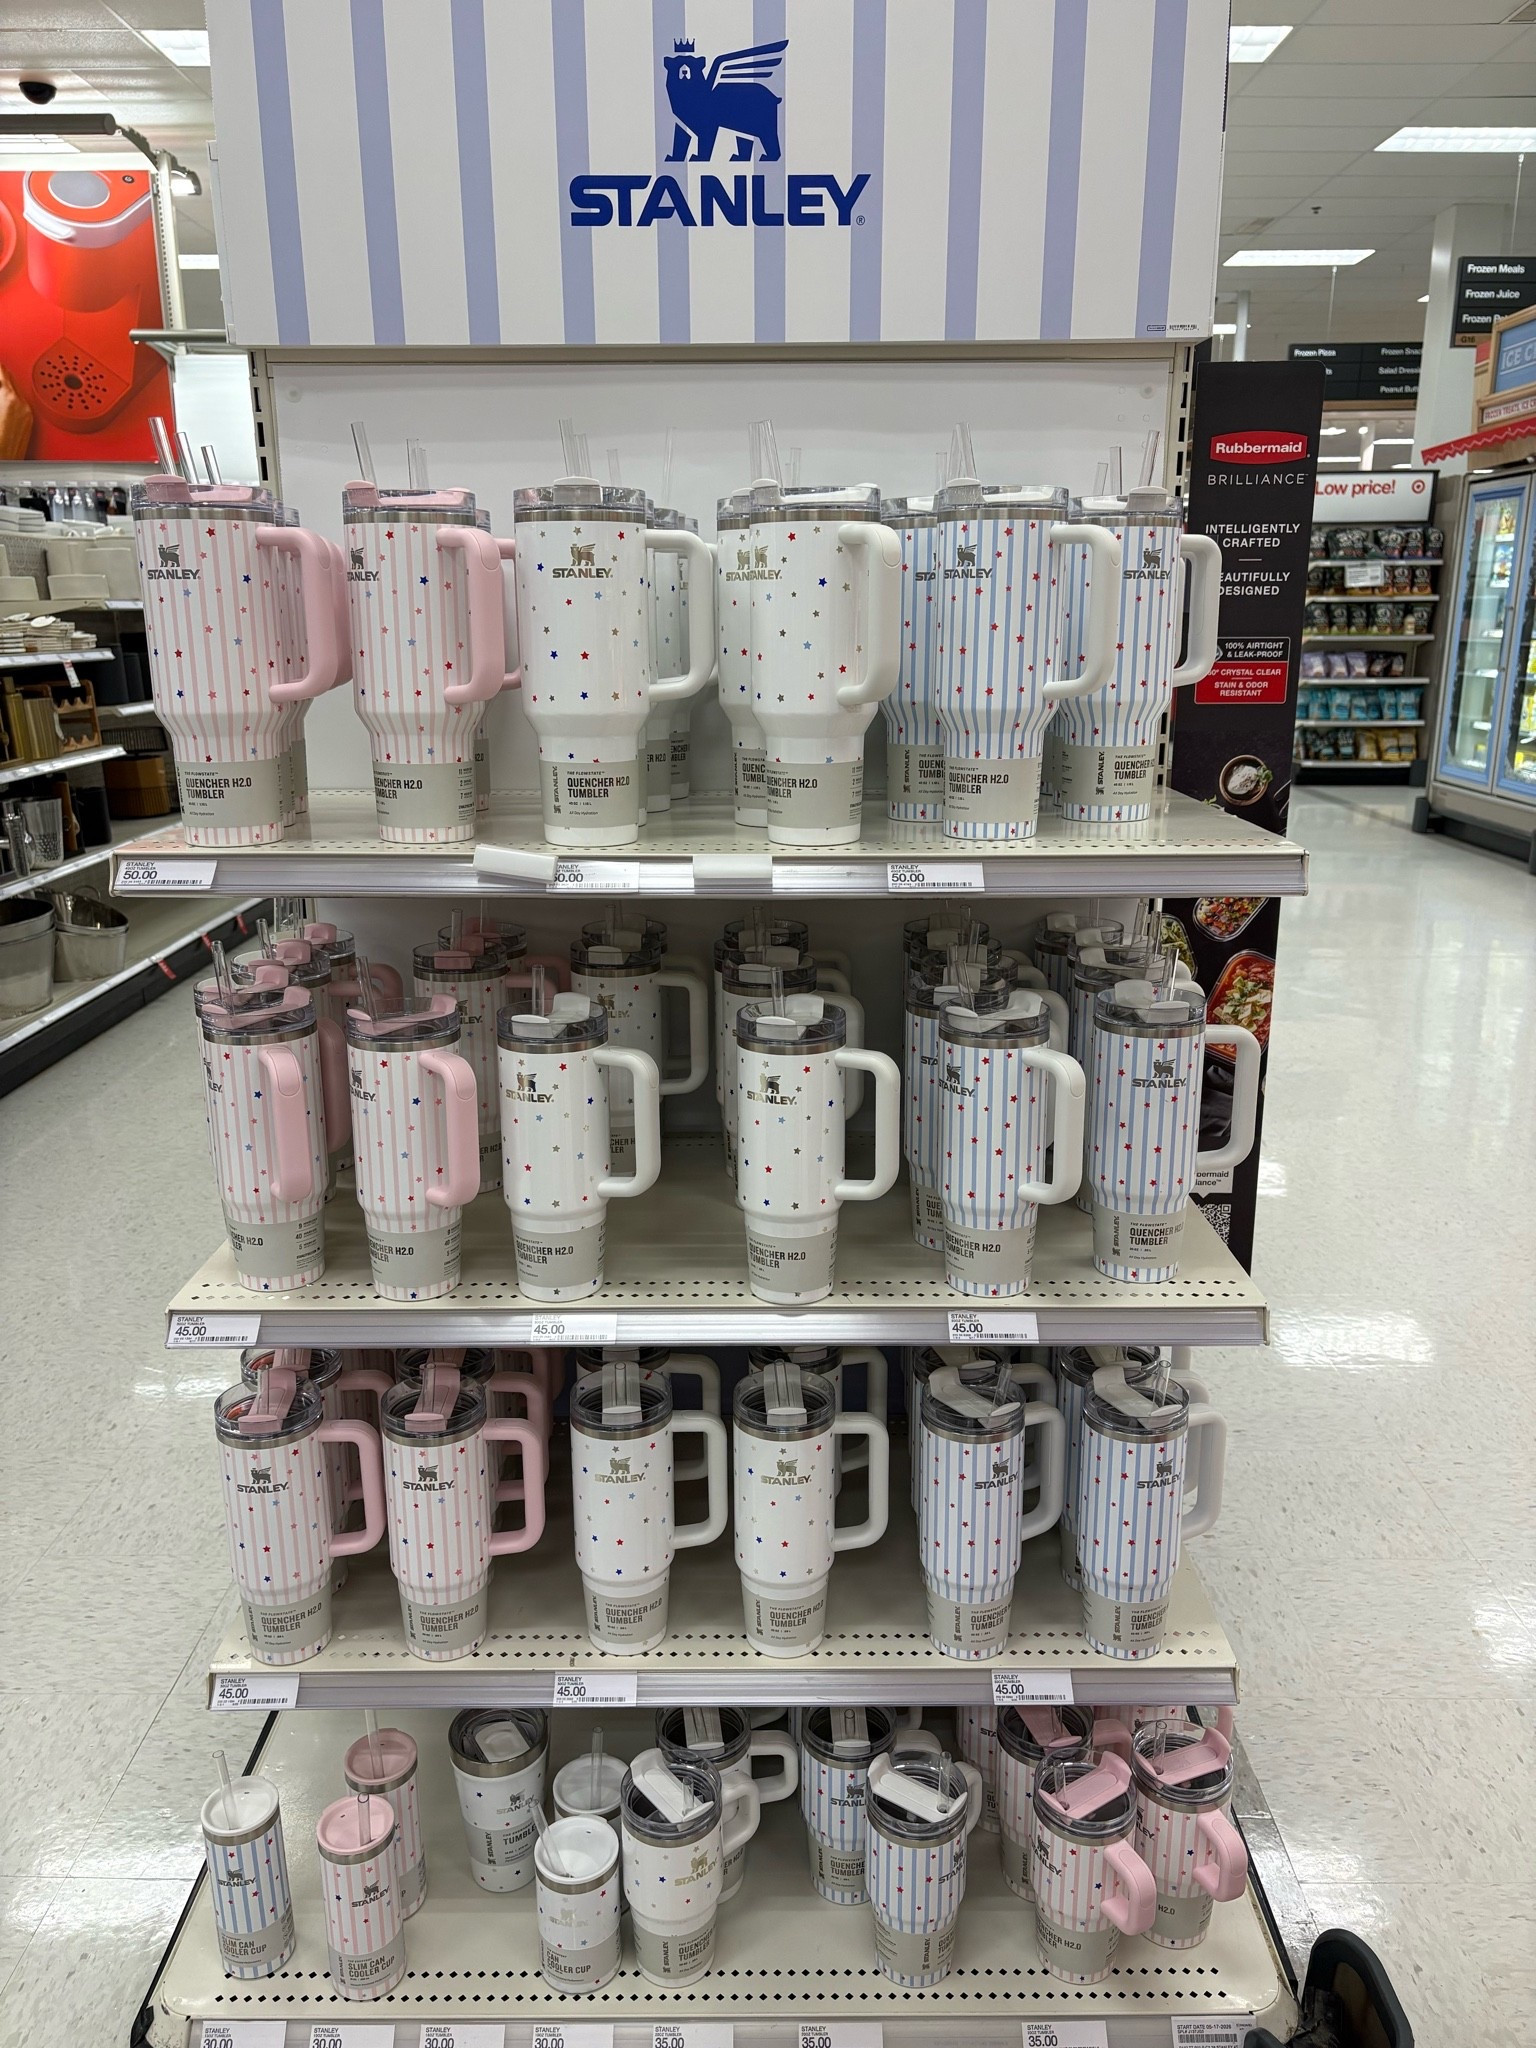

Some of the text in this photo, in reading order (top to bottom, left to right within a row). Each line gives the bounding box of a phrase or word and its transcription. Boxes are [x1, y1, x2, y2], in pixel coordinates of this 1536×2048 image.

[569, 173, 871, 226] STANLEY
[1467, 263, 1525, 274] Frozen Meals
[1465, 288, 1520, 299] Frozen Juice
[1462, 313, 1492, 324] Frozen
[1215, 441, 1302, 454] Rubbermaid
[1207, 473, 1305, 486] BRILLIANCE
[1315, 479, 1396, 498] Low price!
[1205, 523, 1301, 535] INTELLIGENTLY
[1222, 537, 1280, 548] CRAFTED
[148, 568, 200, 580] STANLEY
[552, 568, 612, 579] STANLEY
[944, 568, 993, 579] STANLEY
[1123, 569, 1171, 580] STANLEY
[1219, 572, 1291, 583] EAUTIFULLY
[1225, 641, 1284, 650] 100% AIRTIGHT
[1226, 650, 1284, 658] & LEAK-PROOF
[1214, 681, 1268, 689] STAIN & ODOR
[1219, 689, 1262, 697] RESISTANT
[949, 773, 988, 784] QUENCHER
[1113, 770, 1147, 780] TUMBLER
[185, 778, 230, 788] QUENCHER
[553, 766, 561, 803] STANLEY
[567, 777, 614, 788] QUENCHER
[186, 789, 225, 799] TUMBLER
[567, 787, 609, 798] TUMBLER
[949, 785, 982, 794] TUMBLER
[123, 870, 158, 880] 50.00
[891, 873, 925, 882] 50.00
[1131, 1076, 1187, 1089] STANLEY
[505, 1089, 553, 1104] STANLEY
[747, 1089, 796, 1106] STANLEY
[1129, 1225, 1174, 1238] QUENCHER
[1129, 1236, 1168, 1246] TUMBLER
[174, 1326, 207, 1336] 45.00
[533, 1324, 566, 1335] 45.00
[952, 1323, 984, 1333] 45.00
[594, 1473, 645, 1485] STANLEY
[761, 1474, 812, 1487] STANLEY
[974, 1471, 1018, 1490] STANLEY
[1136, 1471, 1181, 1490] STANLEY
[236, 1481, 288, 1494] STANLEY
[403, 1480, 455, 1493] STANLEY
[606, 1605, 648, 1618] QUENCHER
[770, 1607, 812, 1619] QUENCHER
[971, 1606, 1008, 1623] QUENCHER
[261, 1612, 306, 1625] QUENCHER
[420, 1612, 464, 1625] QUENCHER
[606, 1615, 643, 1626] TUMBLER
[770, 1618, 807, 1628] TUMBLER
[953, 1606, 961, 1634] STANLEY
[971, 1616, 1004, 1631] TUMBLER
[1114, 1606, 1122, 1634] STANLEY
[1131, 1616, 1164, 1631] TUMBLER
[262, 1621, 301, 1633] TUMBLER
[420, 1622, 459, 1633] TUMBLER
[218, 1687, 249, 1699] 45.00
[557, 1686, 587, 1697] 45.00
[995, 1683, 1025, 1695] 45.00
[486, 1832, 494, 1858] STANLEY
[675, 1858, 718, 1886] STANLEY
[218, 1876, 256, 1888] STANLEY
[351, 1885, 390, 1908] STANLEY
[238, 1939, 255, 1949] CAN
[252, 1944, 268, 1955] CUP
[923, 1937, 931, 1964] STANLEY
[348, 1955, 386, 1974] SLIM CAN
[348, 1956, 396, 1981] COOLER CUP
[575, 1964, 592, 1974] CUP
[203, 2038, 233, 2048] 30.00
[312, 2038, 342, 2048] 30.00
[425, 2037, 455, 2048] 30.00
[534, 2037, 564, 2048] 30.00
[655, 2037, 685, 2048] 35.00
[802, 2037, 832, 2048] 35.00
[1028, 2035, 1058, 2047] 35.00
